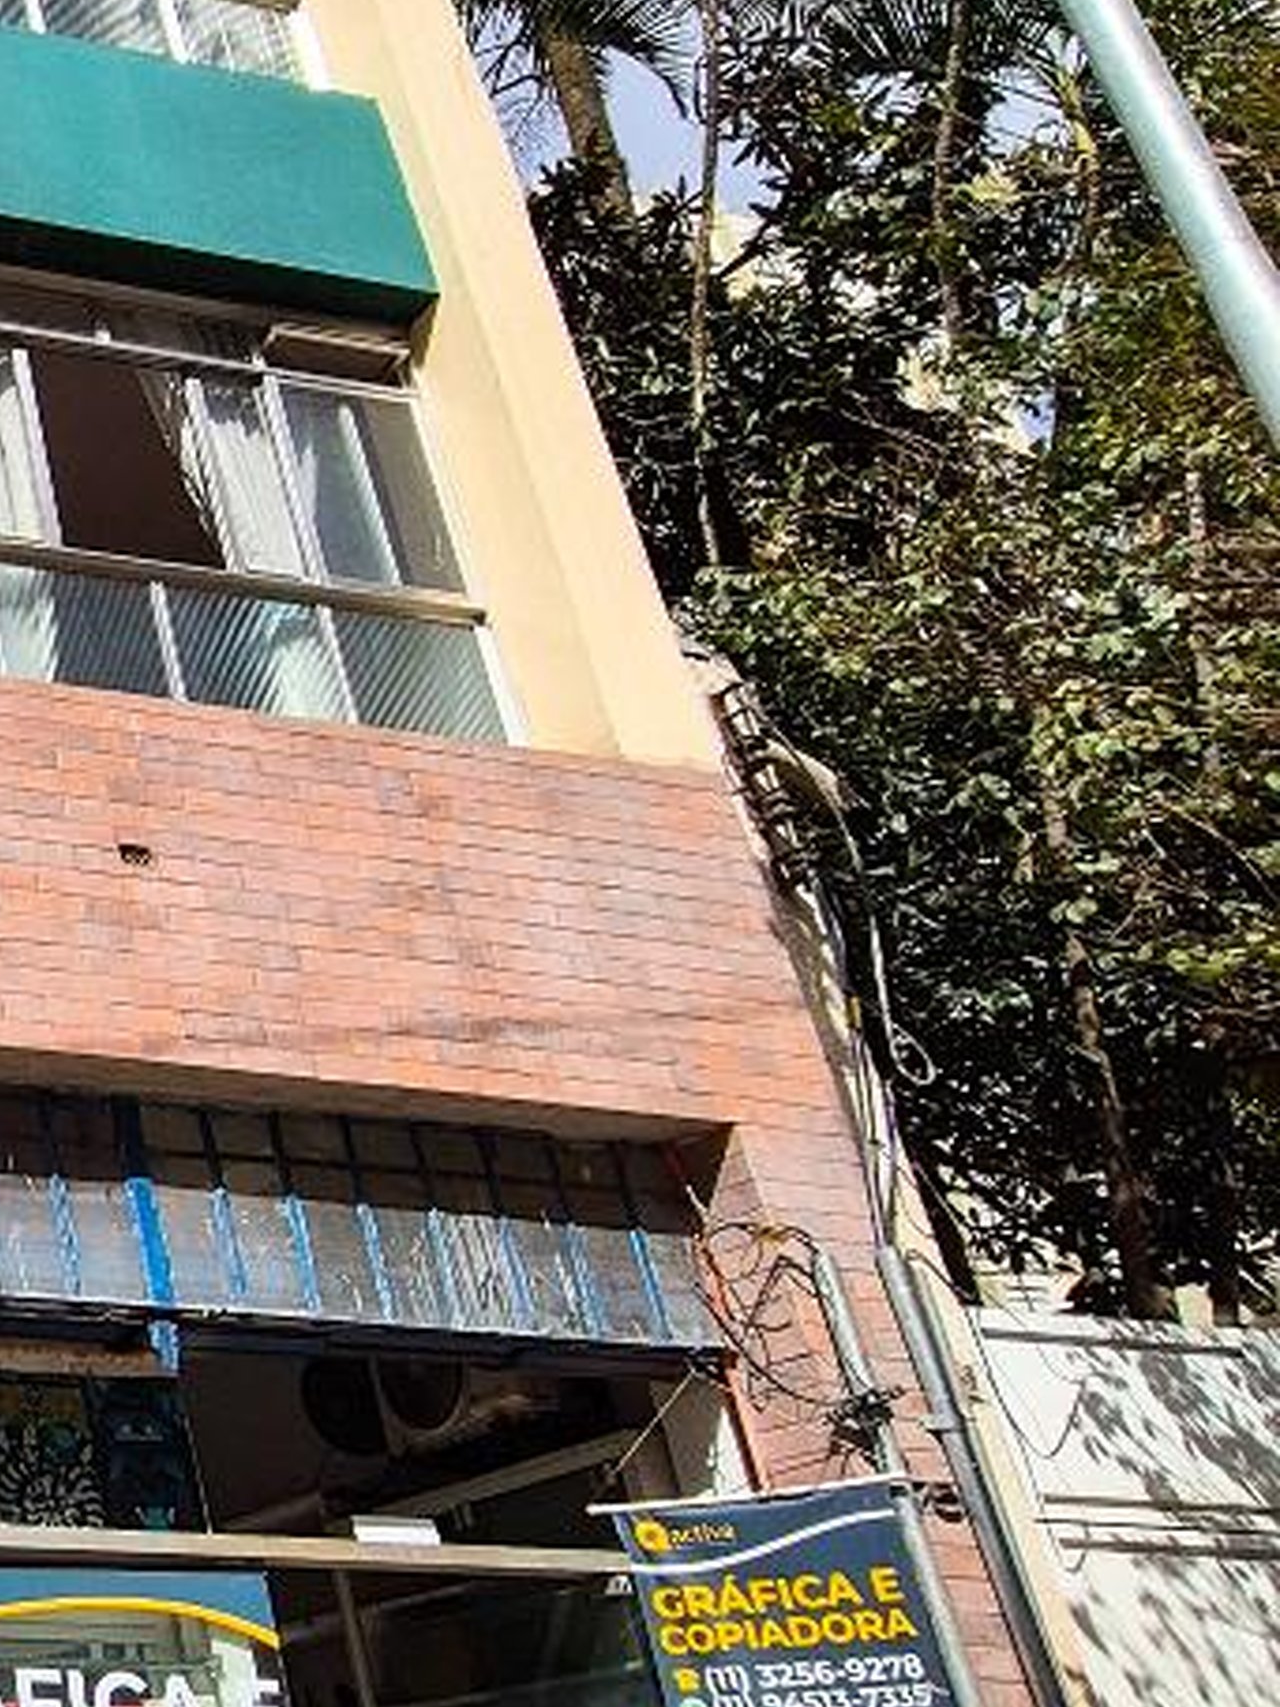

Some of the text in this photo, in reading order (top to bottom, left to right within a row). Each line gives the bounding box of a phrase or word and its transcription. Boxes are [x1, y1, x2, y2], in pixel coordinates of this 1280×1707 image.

[652, 1565, 907, 1619] GRÁFICA E
[659, 1607, 919, 1657] COPIADORA
[704, 1652, 926, 1697] (11) 3256-9278
